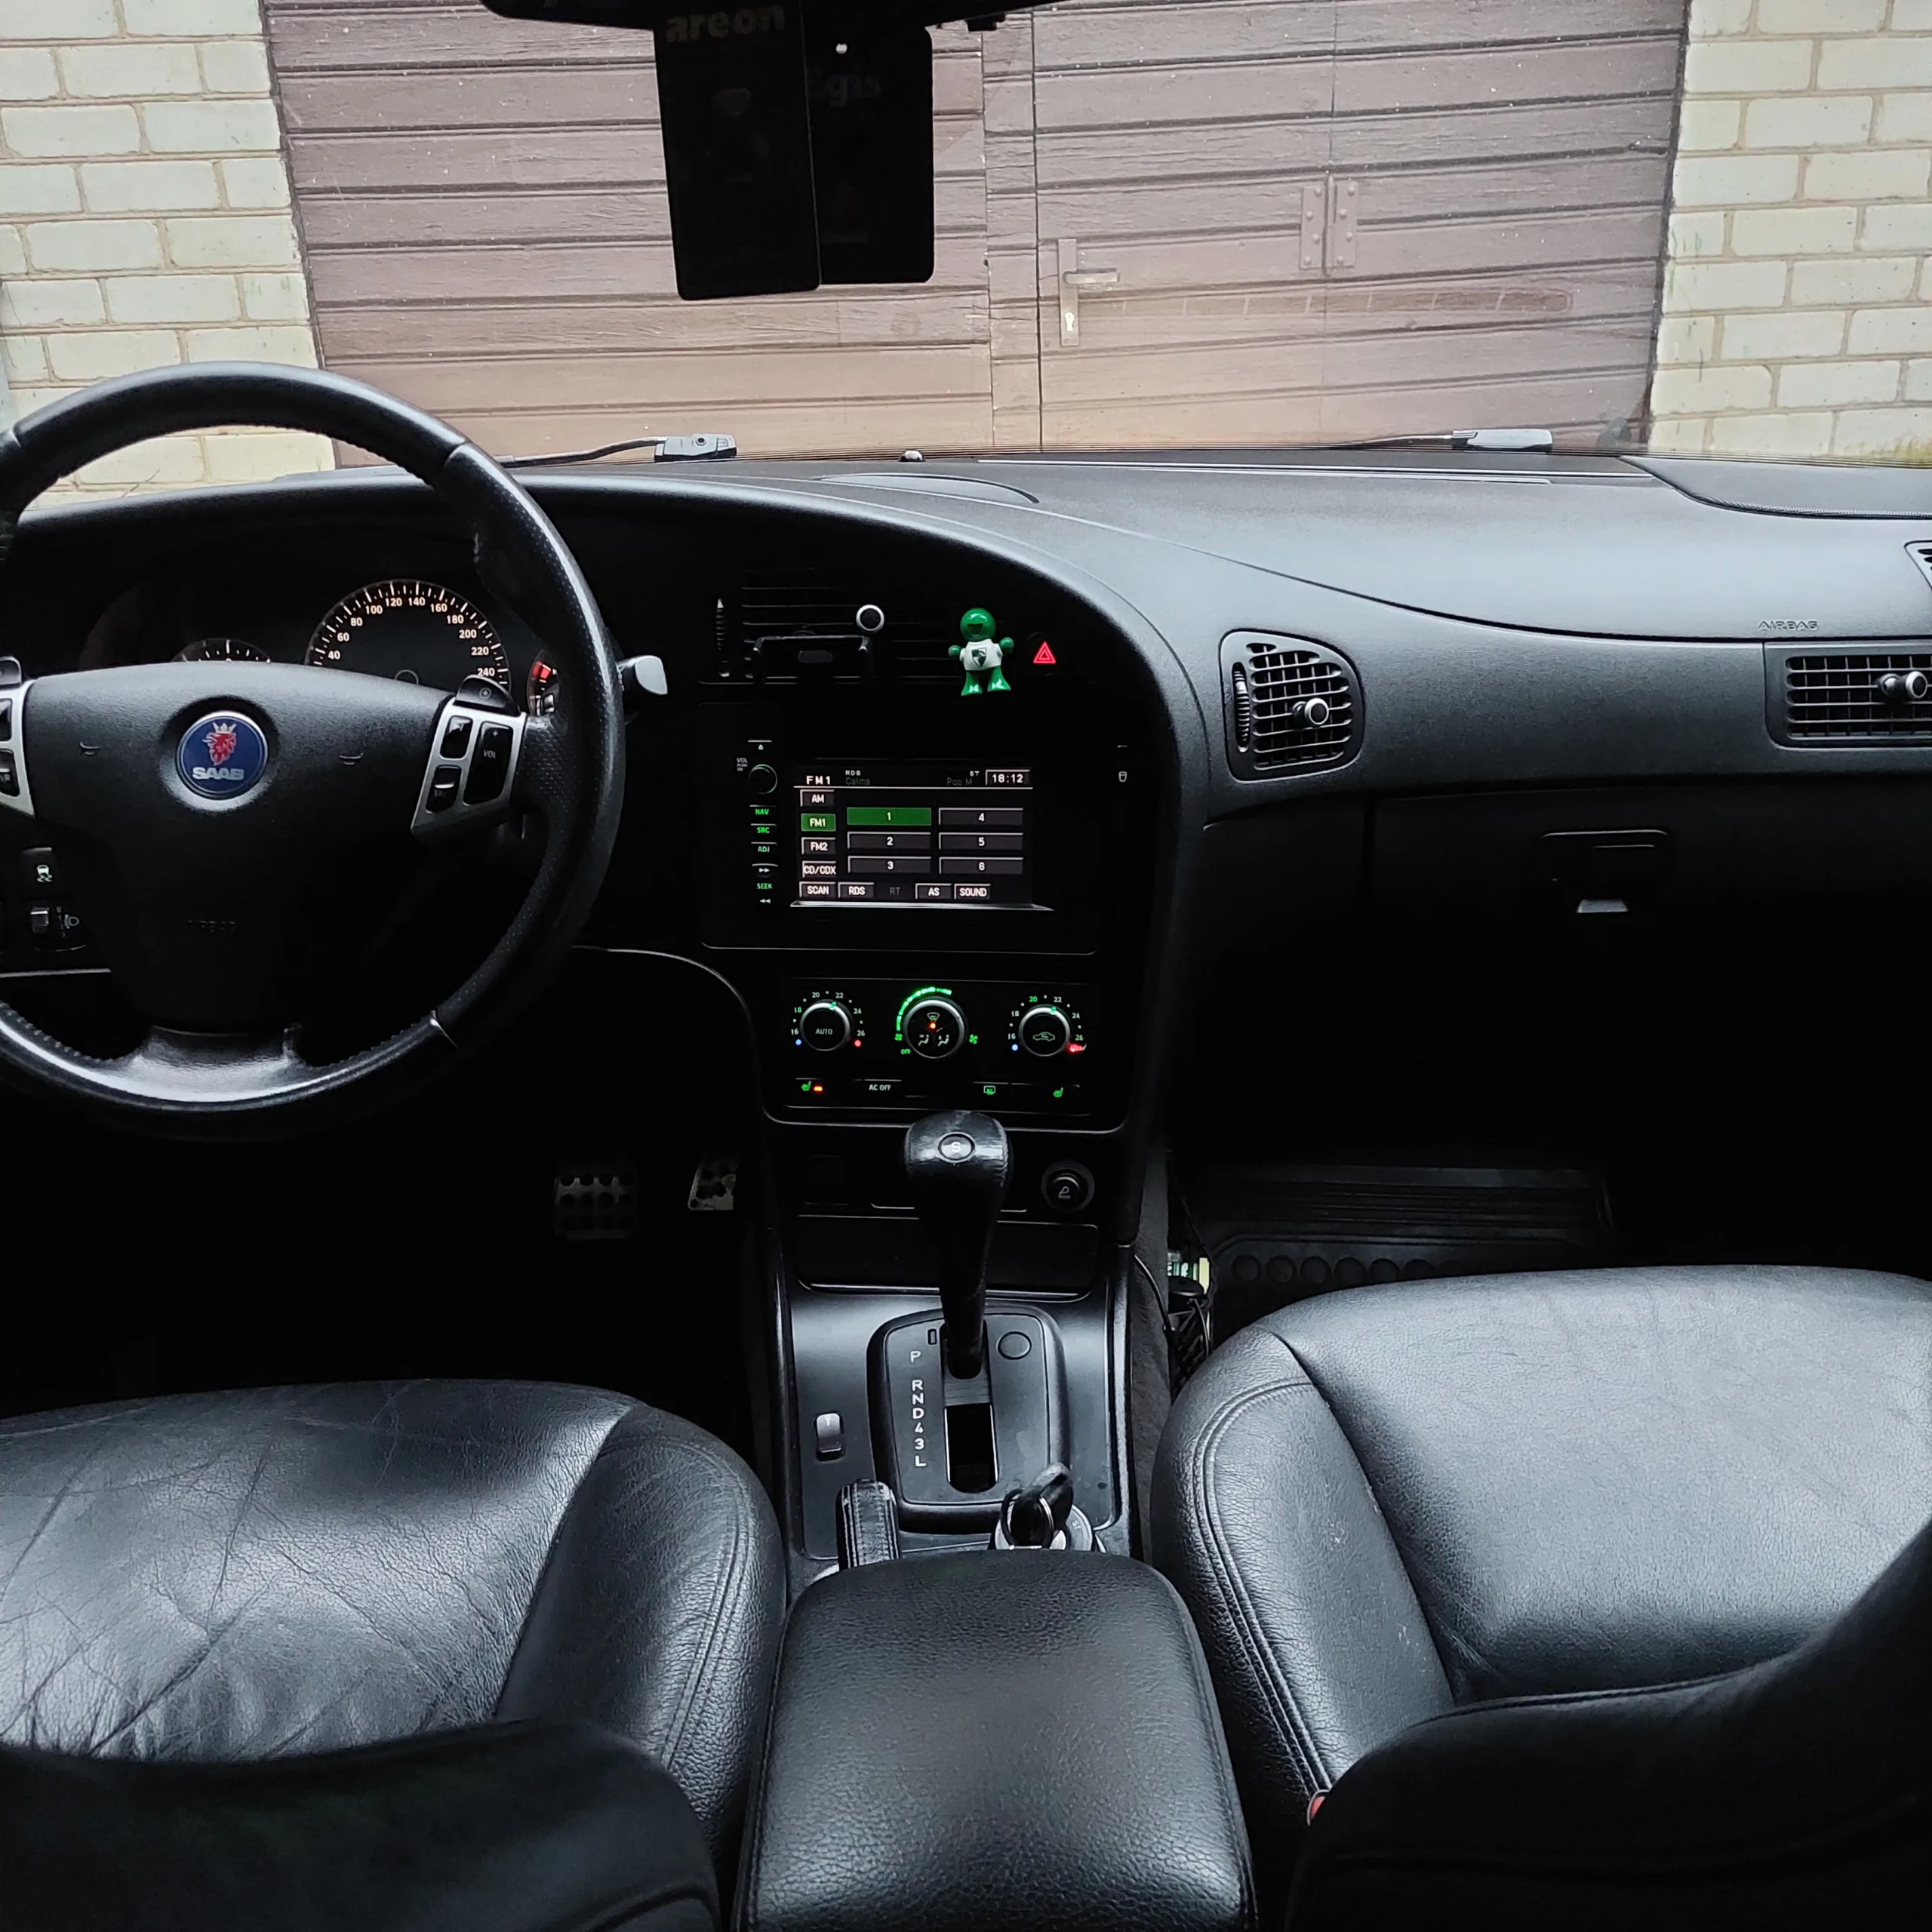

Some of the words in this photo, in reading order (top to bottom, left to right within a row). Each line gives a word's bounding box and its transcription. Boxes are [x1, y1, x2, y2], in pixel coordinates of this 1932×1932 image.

[666, 3, 785, 43] areon
[385, 597, 402, 606] 120
[408, 597, 426, 606] 140
[365, 605, 383, 614] 100
[430, 603, 448, 613] 160
[350, 617, 363, 626] 80
[447, 615, 464, 624] 180
[1758, 620, 1820, 632] AIRBAG
[337, 632, 349, 641] 60
[459, 629, 477, 639] 200
[328, 651, 340, 660] 40
[471, 646, 489, 656] 220
[477, 667, 495, 677] 240
[483, 749, 497, 759] VOL
[192, 766, 245, 780] SAAB
[806, 775, 831, 785] FM1
[991, 774, 1024, 783] 18:12
[811, 794, 825, 804] AM
[809, 817, 826, 827] FM1
[886, 812, 891, 822] 1
[978, 813, 985, 822] 4
[810, 841, 828, 851] FM2
[886, 836, 894, 846] 2
[978, 837, 985, 847] 5
[804, 865, 836, 875] CD/CDX
[887, 860, 894, 870] 3
[978, 862, 986, 871] 6
[807, 885, 829, 895] SCAN
[848, 886, 866, 896] RDS
[890, 887, 900, 897] RT
[928, 887, 940, 897] AS
[958, 887, 987, 897] SOUND
[950, 1141, 961, 1152] S
[910, 1350, 921, 1363] P
[912, 1380, 924, 1391] R
[912, 1393, 924, 1405] N
[912, 1407, 924, 1420] D
[914, 1422, 924, 1434] 4
[914, 1438, 924, 1450] 3
[915, 1455, 927, 1468] L
